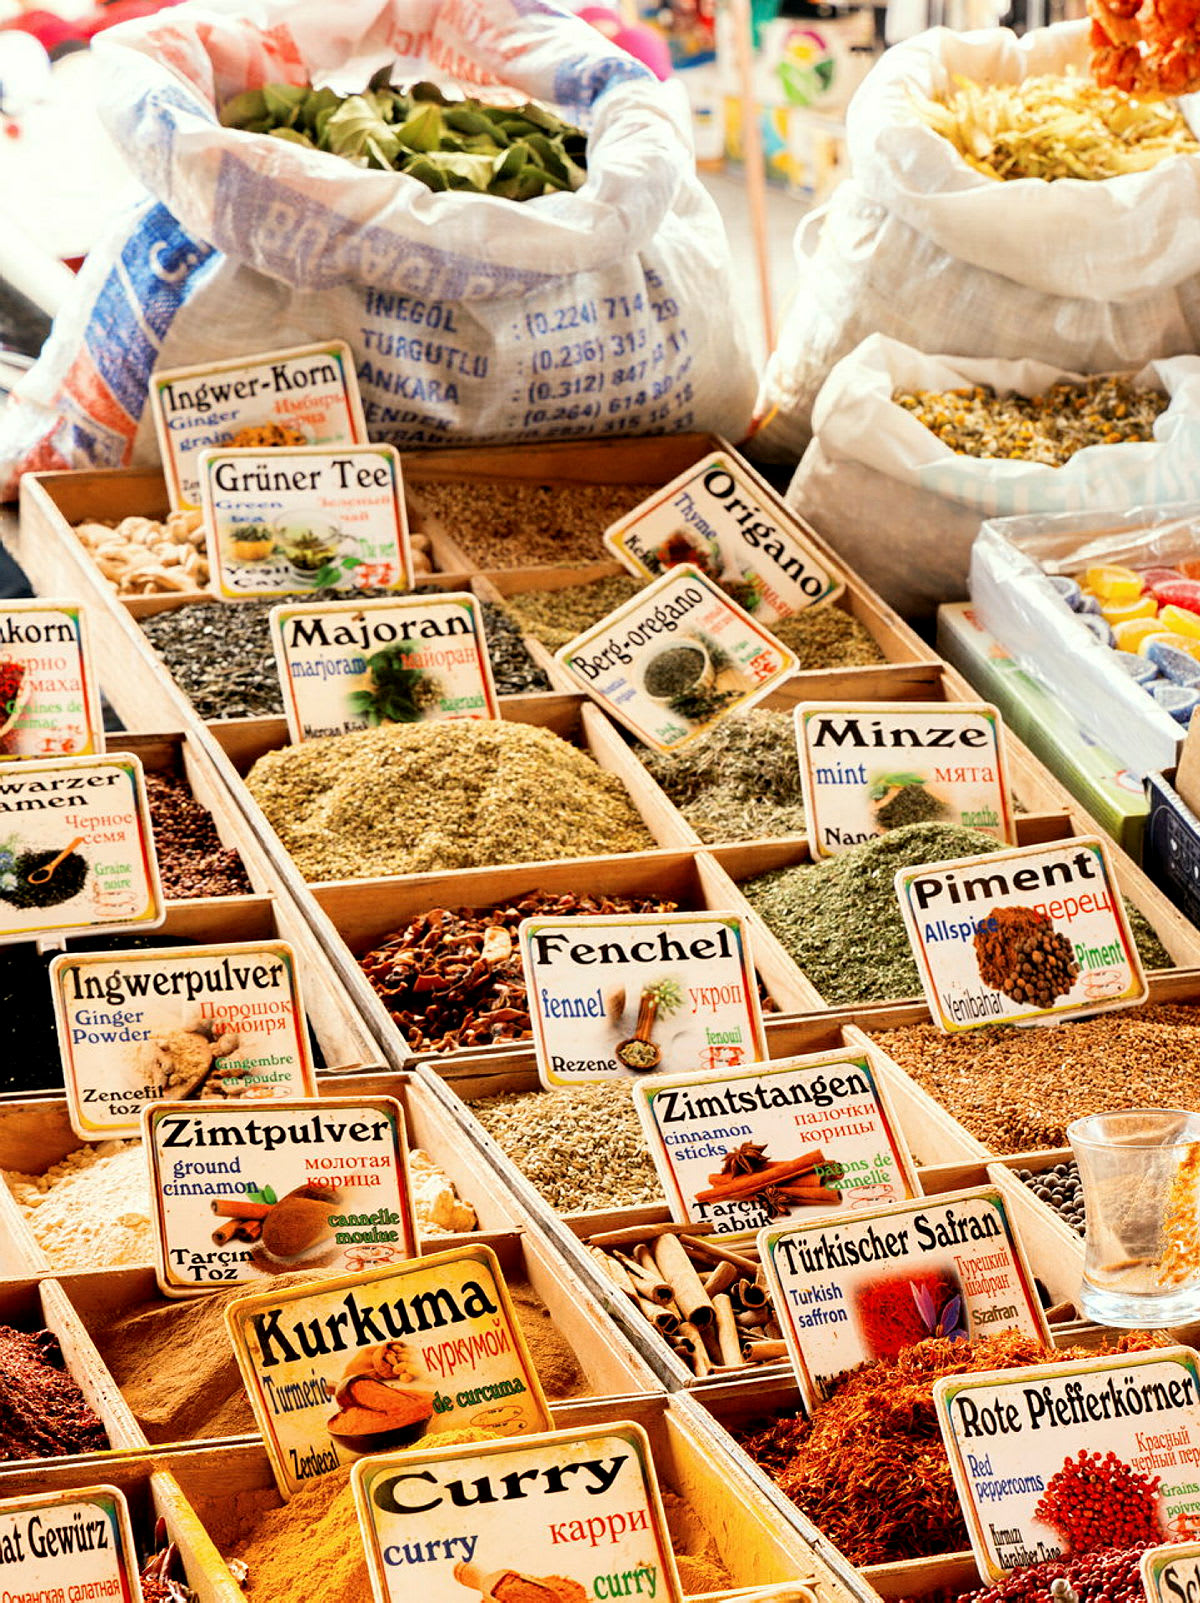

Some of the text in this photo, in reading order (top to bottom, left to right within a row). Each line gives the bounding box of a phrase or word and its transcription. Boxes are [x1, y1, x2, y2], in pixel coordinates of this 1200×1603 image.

[361, 327, 489, 379] TURGUTLU
[165, 363, 337, 412] Ingwer-Korn
[357, 360, 460, 405] ANKARA
[168, 409, 240, 430] Ginger
[362, 396, 456, 432] ENDEK
[180, 430, 234, 451] grain
[215, 463, 321, 492] Grüner
[332, 460, 390, 488] Tee
[216, 501, 283, 509] Green
[674, 492, 717, 541] Thyme
[703, 470, 822, 598] Origano
[0, 618, 77, 643] korn
[291, 616, 474, 649] Majoran
[572, 588, 703, 680] Berg-oregano
[291, 655, 368, 681] marjoram
[401, 647, 477, 672] майоран
[813, 719, 988, 748] Minze
[816, 763, 868, 785] mint
[935, 766, 994, 783] мята
[960, 806, 999, 828] menthe
[82, 832, 126, 845] семя
[913, 853, 1095, 909] Piment
[1033, 889, 1112, 922] перец
[925, 915, 999, 944] Allspice
[535, 928, 733, 966] Fenchel
[1075, 939, 1125, 971] Piment
[70, 958, 284, 1006] Ingwerpulver
[200, 999, 293, 1021] Порошок
[542, 988, 607, 1019] fennel
[688, 983, 742, 1014] укроп
[943, 988, 1004, 1024] Yenibahar
[75, 1009, 144, 1028] Ginger
[213, 1016, 287, 1036] имбиря
[73, 1028, 151, 1045] Powder
[705, 1026, 743, 1045] fenouil
[215, 1054, 294, 1073] Gingembre
[551, 1055, 618, 1072] Rezene
[222, 1071, 292, 1088] en poudre
[83, 1086, 165, 1103] Zencefil
[657, 1071, 871, 1124] Zimtstangen
[108, 1102, 142, 1115] toz
[793, 1102, 877, 1128] палочки
[161, 1116, 390, 1150] Zimtpulver
[664, 1124, 753, 1146] cinnamon
[799, 1119, 875, 1144] корицы
[305, 1156, 390, 1171] молотая
[675, 1142, 729, 1162] sticks
[873, 1152, 894, 1168] de
[173, 1157, 241, 1179] ground
[163, 1180, 260, 1197] cinnamon
[307, 1173, 381, 1192] корица
[824, 1170, 892, 1193] cannelle
[327, 1209, 400, 1227] cannelle
[697, 1211, 774, 1237] abuk
[335, 1228, 399, 1244] moulue
[778, 1209, 1002, 1276] Türkischer Safran
[170, 1248, 255, 1267] Tarçın
[954, 1249, 1010, 1277] Турецкий
[187, 1264, 239, 1281] Toz
[789, 1282, 843, 1307] Turkish
[965, 1273, 1010, 1299] шафран
[254, 1281, 497, 1368] Kurkuma
[798, 1306, 848, 1329] saffron
[972, 1303, 1019, 1326] Szafran
[422, 1318, 510, 1378] куркумой
[263, 1368, 333, 1415] Turmeric
[432, 1375, 526, 1414] de curcuma
[959, 1375, 1195, 1437] Rote Pfefferkörner
[1135, 1426, 1190, 1449] Красный
[967, 1453, 993, 1478] Red
[1131, 1447, 1175, 1472] черный
[374, 1453, 629, 1515] Curry
[975, 1472, 1044, 1503] peppercorns
[1160, 1481, 1199, 1499] Grains
[1166, 1499, 1200, 1517] poivre
[0, 1512, 108, 1564] at Gewürz
[549, 1509, 648, 1551] карри
[383, 1534, 478, 1567] curry
[592, 1564, 657, 1600] curry
